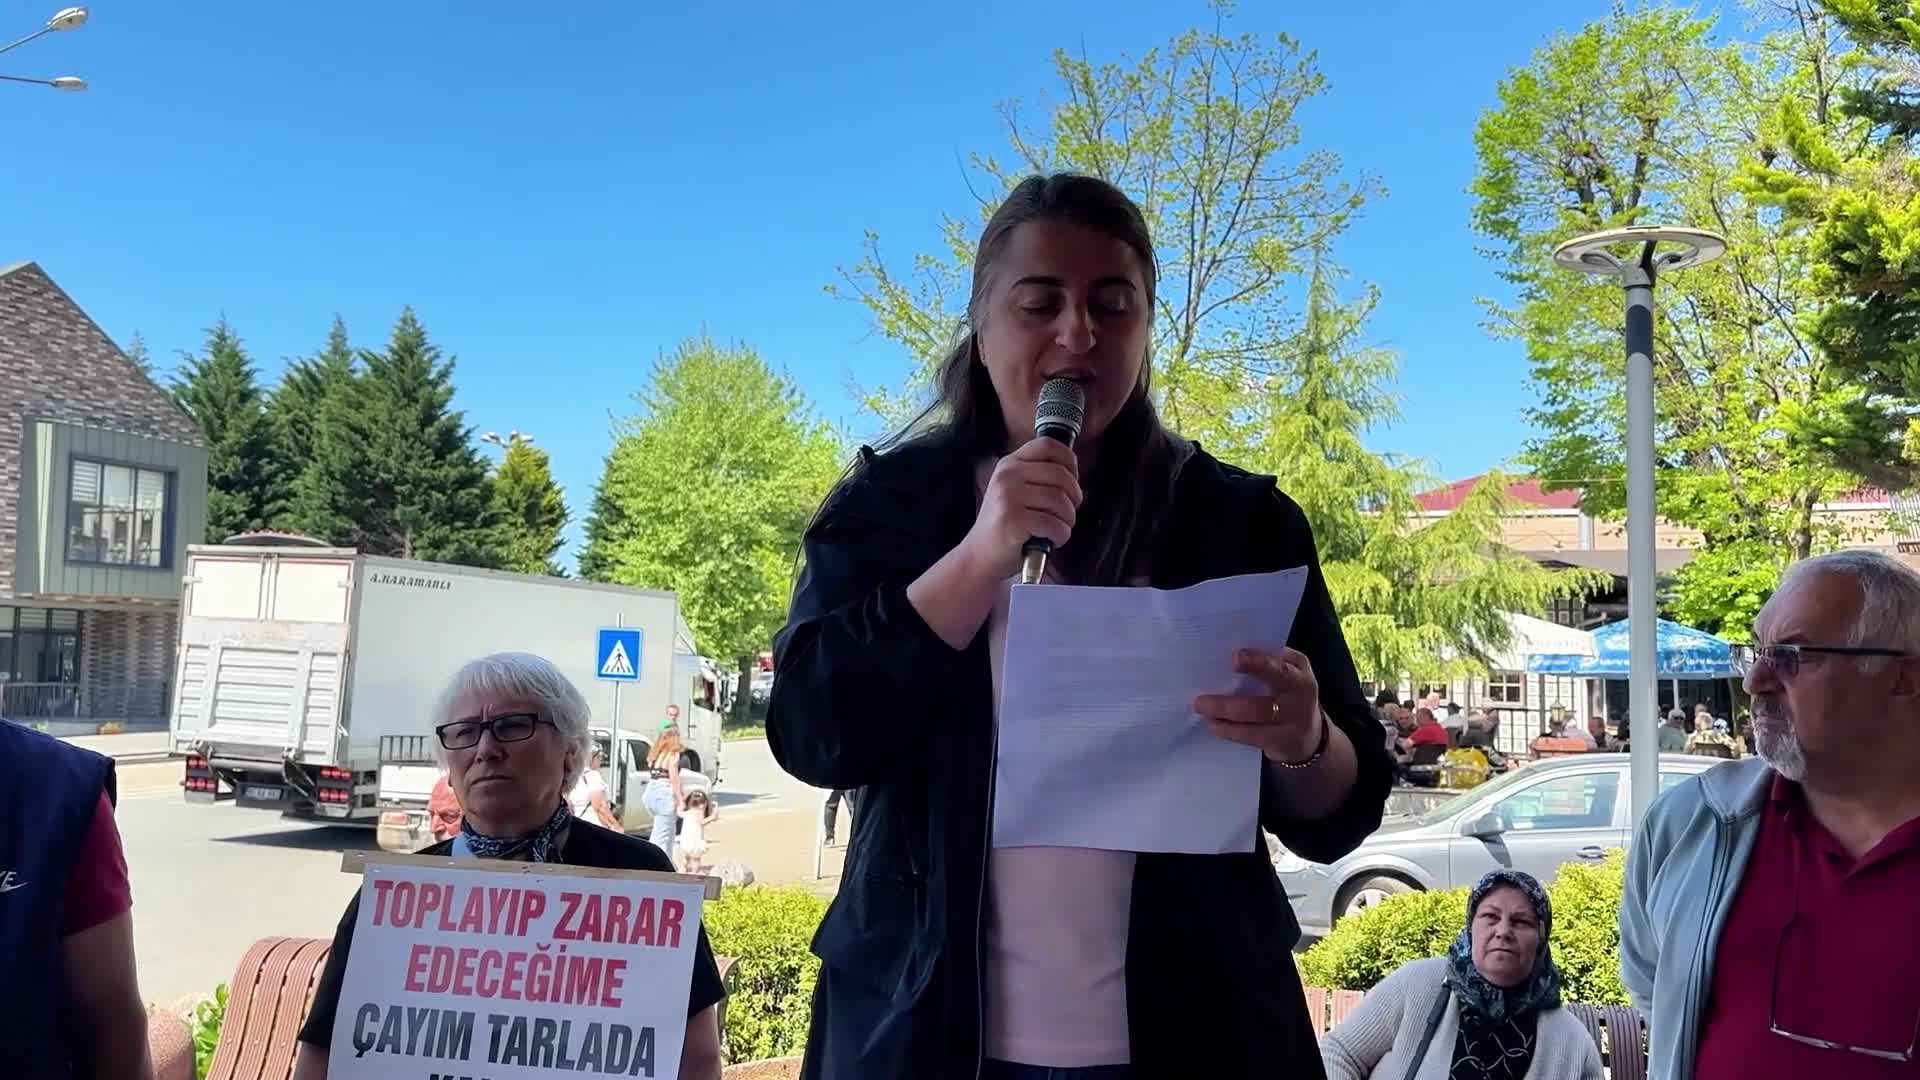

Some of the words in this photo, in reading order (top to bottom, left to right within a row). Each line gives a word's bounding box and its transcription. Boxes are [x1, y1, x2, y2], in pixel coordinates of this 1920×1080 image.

[373, 880, 547, 937] TOPLAYIP
[553, 892, 685, 948] ZARAR
[404, 942, 628, 1009] EDECEĞİME
[352, 1002, 476, 1059] ÇAYIM
[487, 1013, 656, 1079] TARLADA
